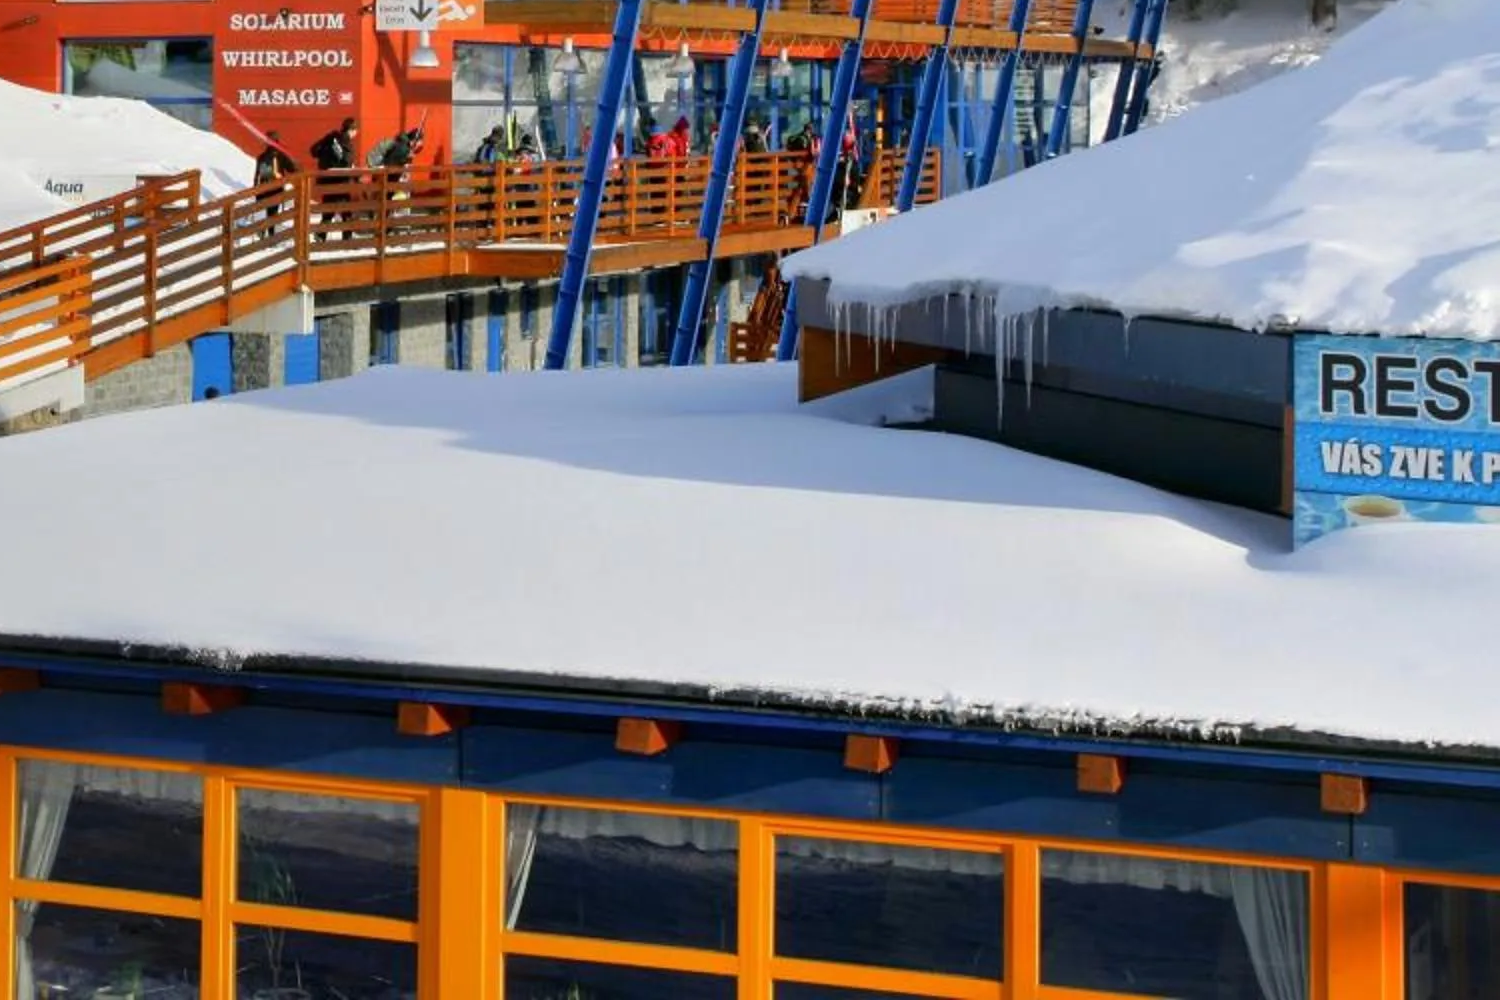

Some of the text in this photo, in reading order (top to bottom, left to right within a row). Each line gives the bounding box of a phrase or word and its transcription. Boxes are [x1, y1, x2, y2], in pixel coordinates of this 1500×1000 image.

[230, 12, 345, 31] SOLARIUM
[222, 50, 353, 68] WHIRLPOOL
[238, 88, 330, 106] MASAGE
[44, 178, 84, 197] Aqua
[1320, 350, 1500, 424] REST
[1320, 437, 1382, 478] VÁS
[1389, 445, 1444, 481] ZVE
[1452, 450, 1476, 484] K
